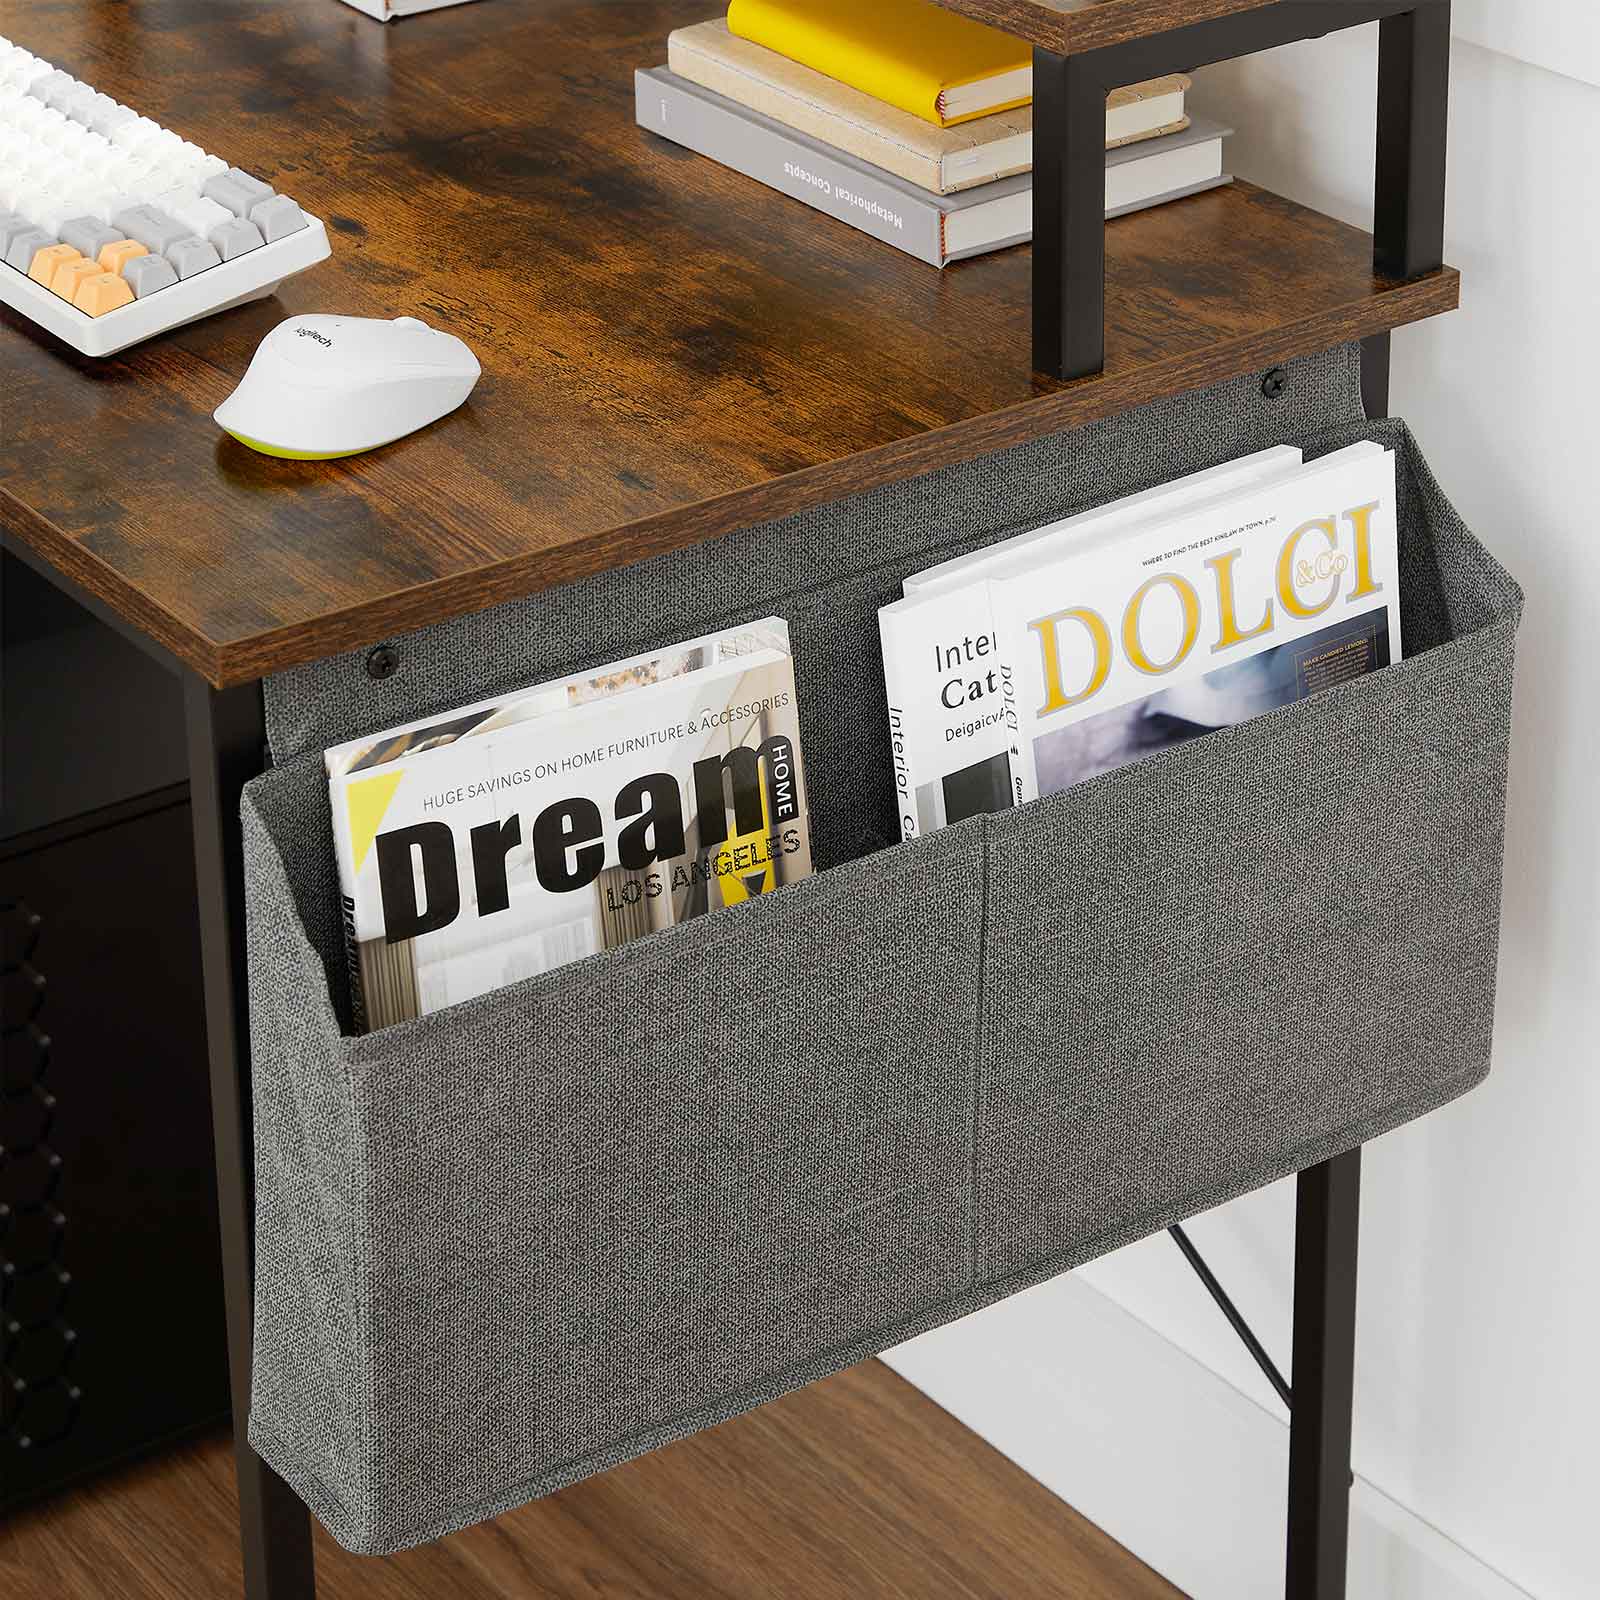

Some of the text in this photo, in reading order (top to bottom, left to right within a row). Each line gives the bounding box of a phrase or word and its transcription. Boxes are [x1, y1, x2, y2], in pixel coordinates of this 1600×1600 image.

[783, 161, 903, 230] Metaphorical Concepts
[294, 328, 332, 348] logitech
[1142, 556, 1164, 567] WHERE
[1164, 551, 1173, 560] TO
[1173, 546, 1188, 557] FIND
[1187, 542, 1199, 552] THE
[1199, 536, 1214, 548] BEST
[1238, 525, 1246, 533] IN
[1027, 500, 1384, 719] DOLCI
[1000, 664, 1018, 732] DOLCI
[423, 692, 790, 812] HUGE SAVINGS ON HOME FURNITURE & ACCESSORIES
[771, 743, 794, 817] HOME
[889, 706, 909, 799] Interior
[376, 734, 799, 944] Dream
[606, 829, 801, 912] LOS ANGELES
